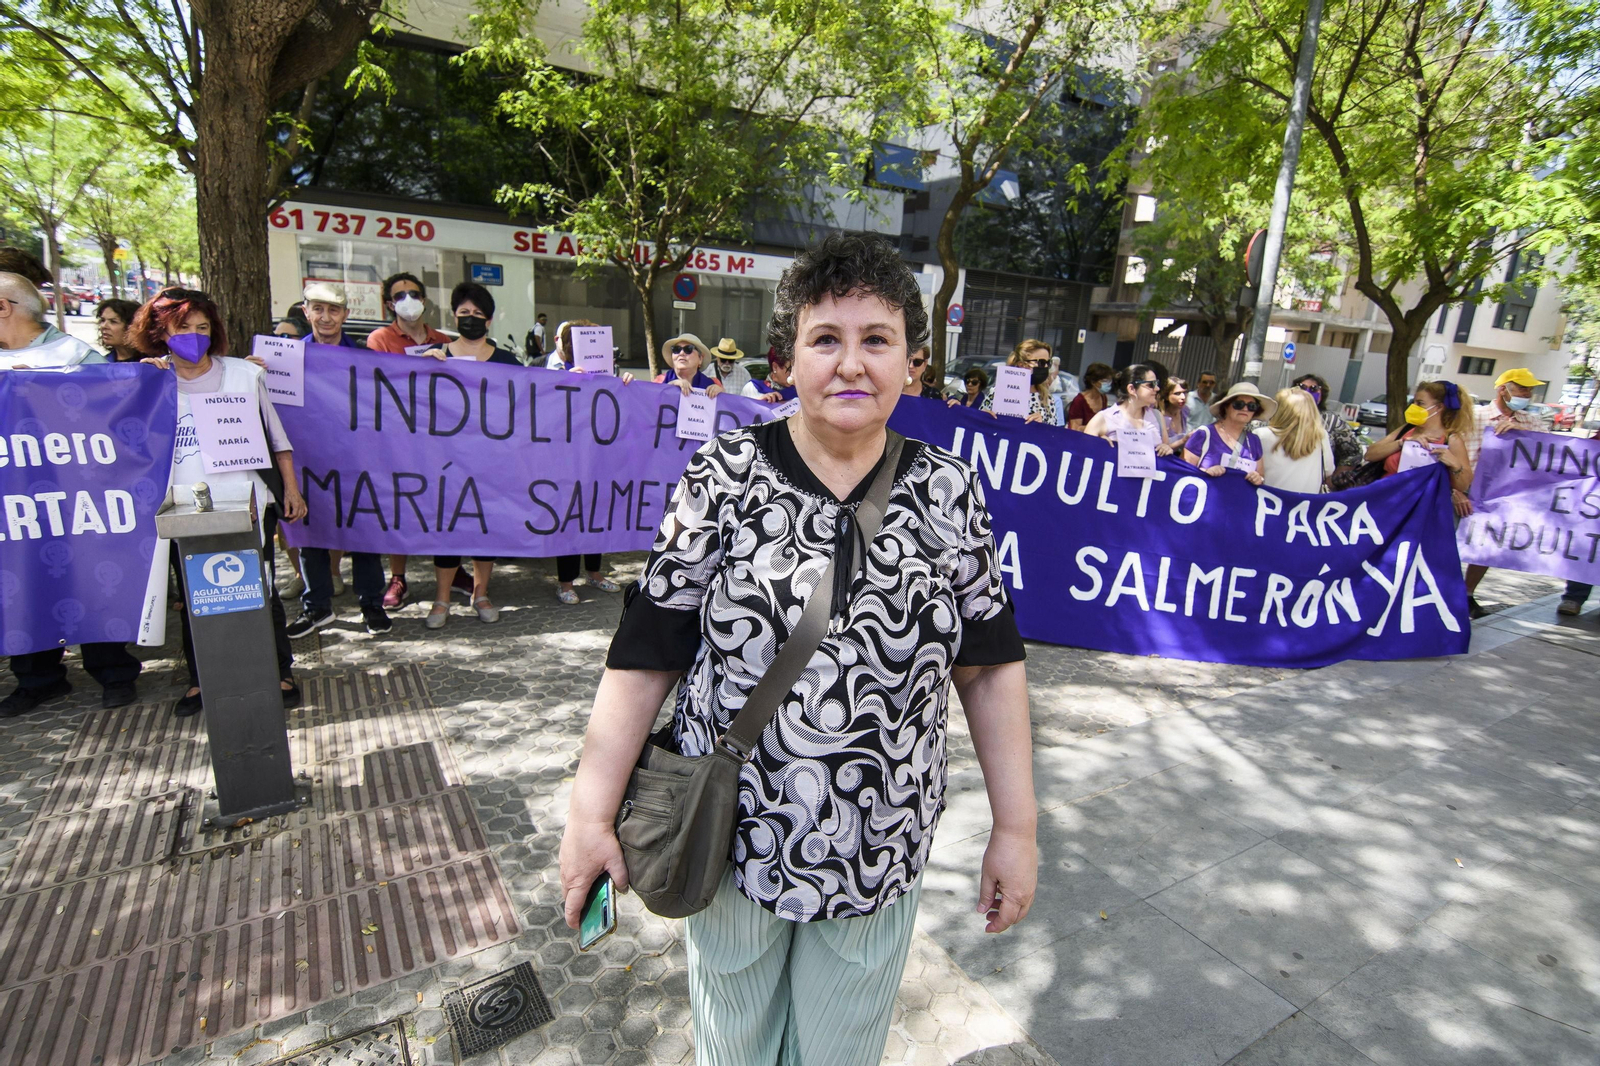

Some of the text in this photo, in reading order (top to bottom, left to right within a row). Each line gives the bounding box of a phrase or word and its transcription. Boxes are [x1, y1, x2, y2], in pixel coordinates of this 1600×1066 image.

[313, 210, 366, 236] 737
[376, 216, 435, 241] 250
[513, 231, 548, 254] SE
[727, 255, 754, 274] M²
[266, 369, 291, 377] USTICIA
[1004, 369, 1026, 377] INDULTO
[267, 387, 297, 396] TRIARCAL
[350, 364, 620, 446] INDULTO
[218, 436, 250, 446] MARÍA
[680, 429, 708, 438] SALMERÓN
[212, 456, 264, 468] SALMERÓN
[1509, 439, 1600, 482] NIN
[302, 461, 488, 534] MARÍA
[952, 426, 1384, 547] INDULTO PARA
[0, 490, 137, 541] RTAD
[1550, 486, 1600, 519] ES
[193, 583, 260, 597] AGUA POTABLE
[193, 592, 262, 605] DRINKING WATER
[1069, 546, 1362, 628] SALMERÓN
[1361, 541, 1462, 637] YA
